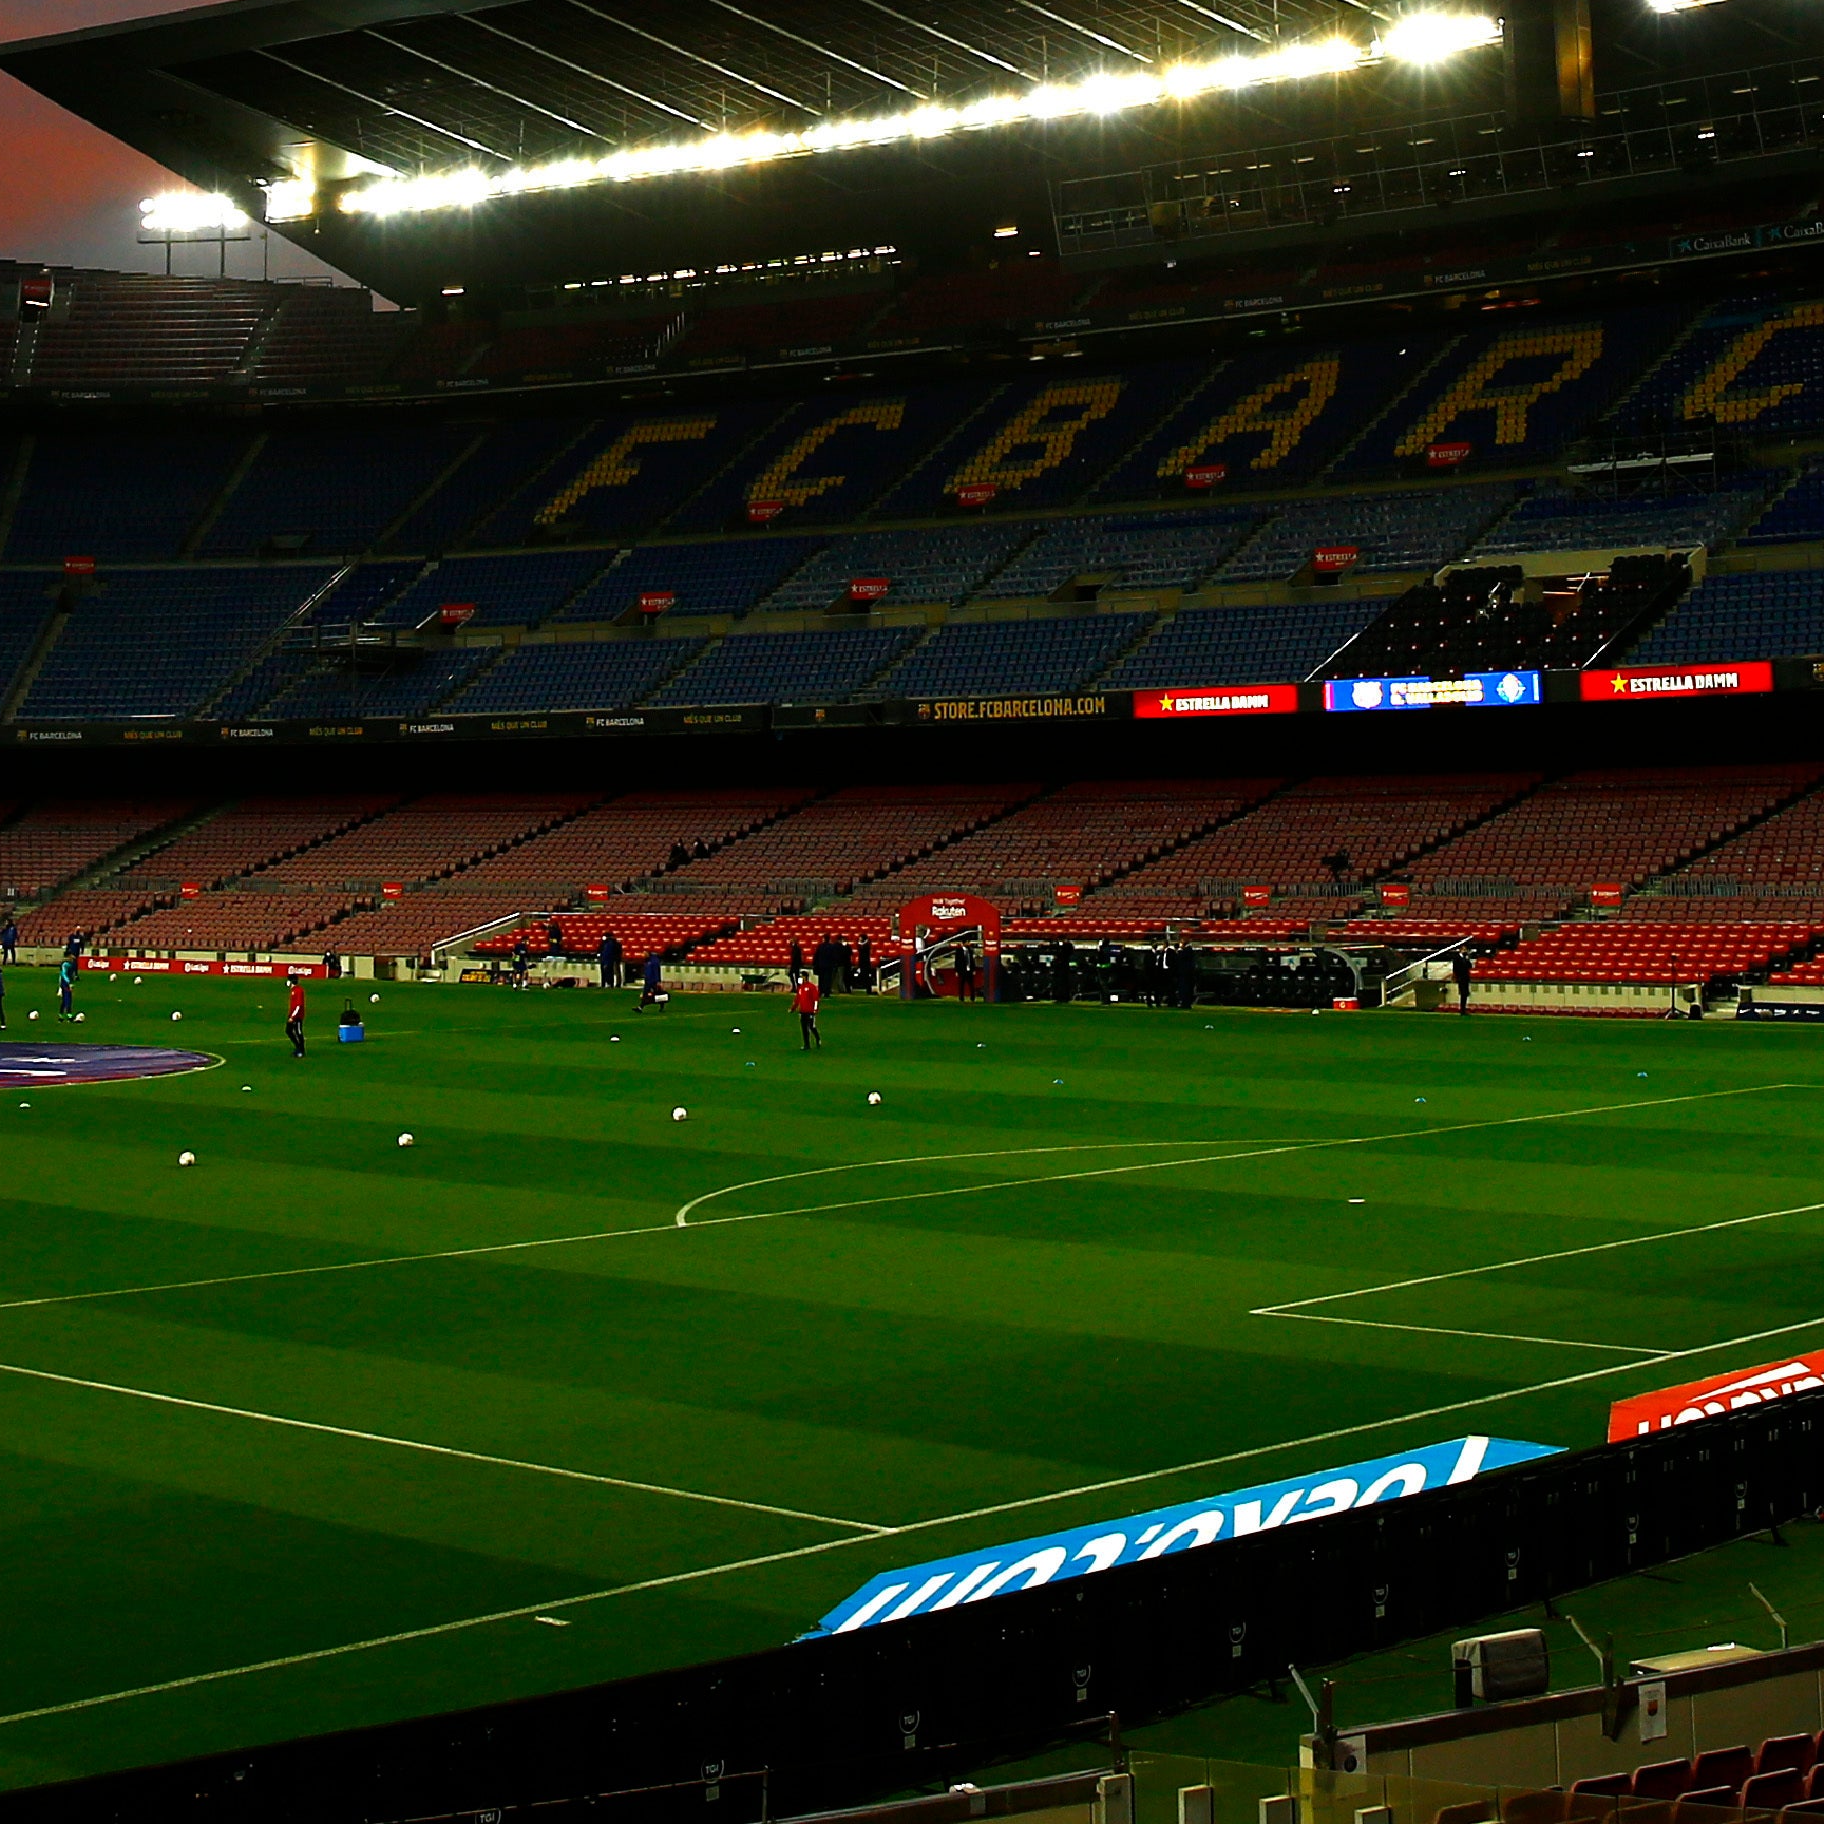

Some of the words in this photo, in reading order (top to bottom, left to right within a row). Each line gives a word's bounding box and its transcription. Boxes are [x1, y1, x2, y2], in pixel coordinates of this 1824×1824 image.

[1693, 234, 1752, 251] CaixaBank
[1629, 676, 1694, 693] ESTRELLA
[1695, 673, 1738, 689] DAMM
[934, 696, 1105, 719] STORE.FCBARCELONA.COM
[1175, 697, 1231, 711] ESTRELLA
[1232, 695, 1269, 710] DAMM
[596, 718, 604, 727] FC
[605, 717, 644, 726] BARCELONA
